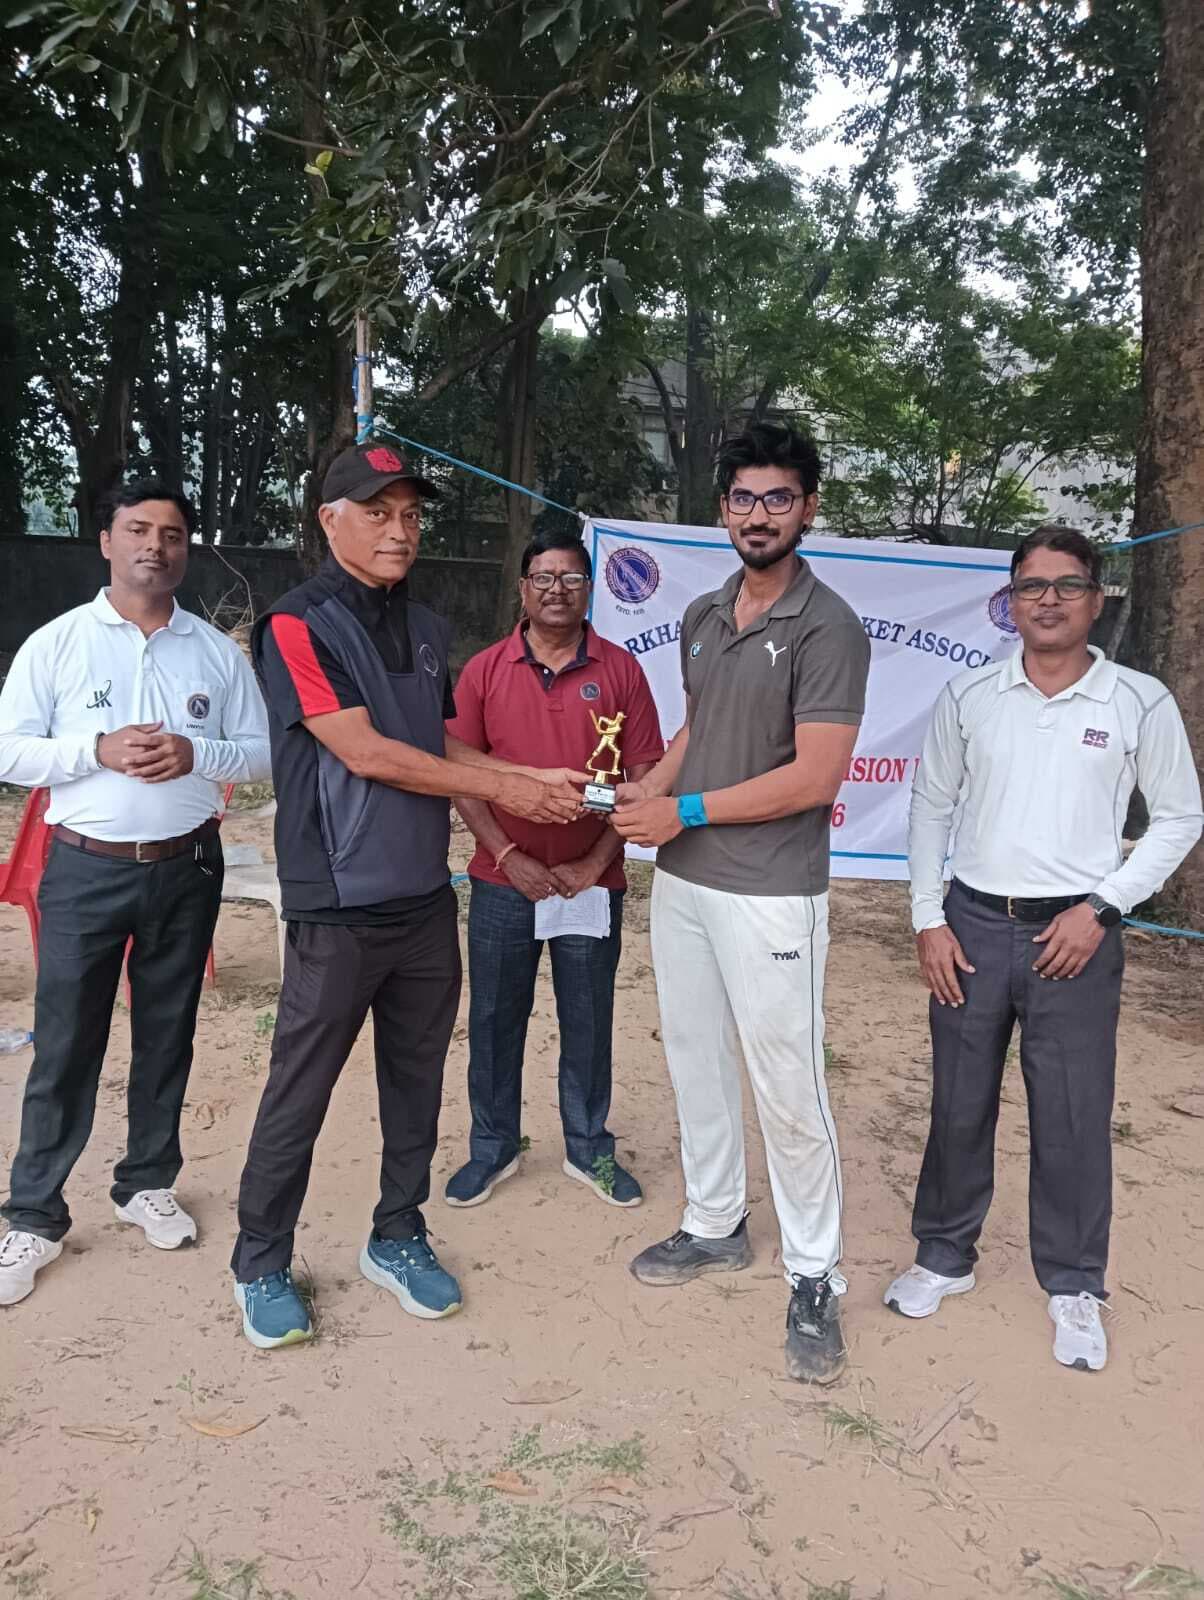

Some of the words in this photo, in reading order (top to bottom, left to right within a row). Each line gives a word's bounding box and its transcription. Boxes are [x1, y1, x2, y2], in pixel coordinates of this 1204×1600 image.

[624, 620, 681, 657] RKHA
[861, 616, 905, 643] KET
[905, 628, 991, 669] ASSOCI
[1084, 727, 1109, 743] RR
[832, 803, 846, 828] 6
[771, 950, 800, 960] TYKA
